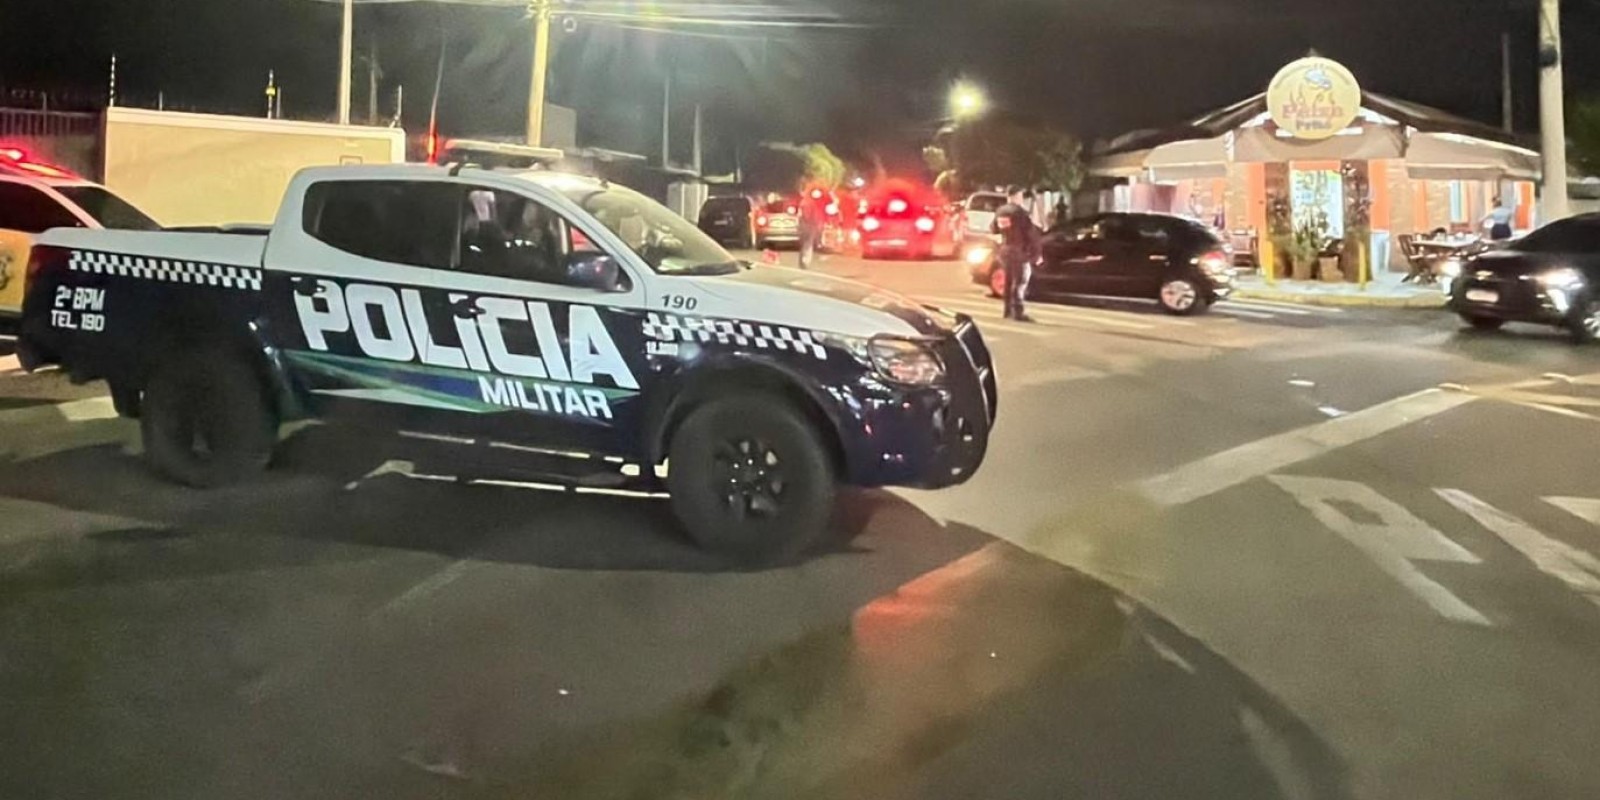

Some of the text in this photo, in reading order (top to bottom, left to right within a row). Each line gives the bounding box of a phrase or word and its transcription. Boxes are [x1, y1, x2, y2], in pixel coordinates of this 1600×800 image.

[73, 287, 105, 311] BPM
[661, 294, 697, 311] 190
[81, 313, 105, 332] 190
[478, 375, 613, 419] MILITAR
